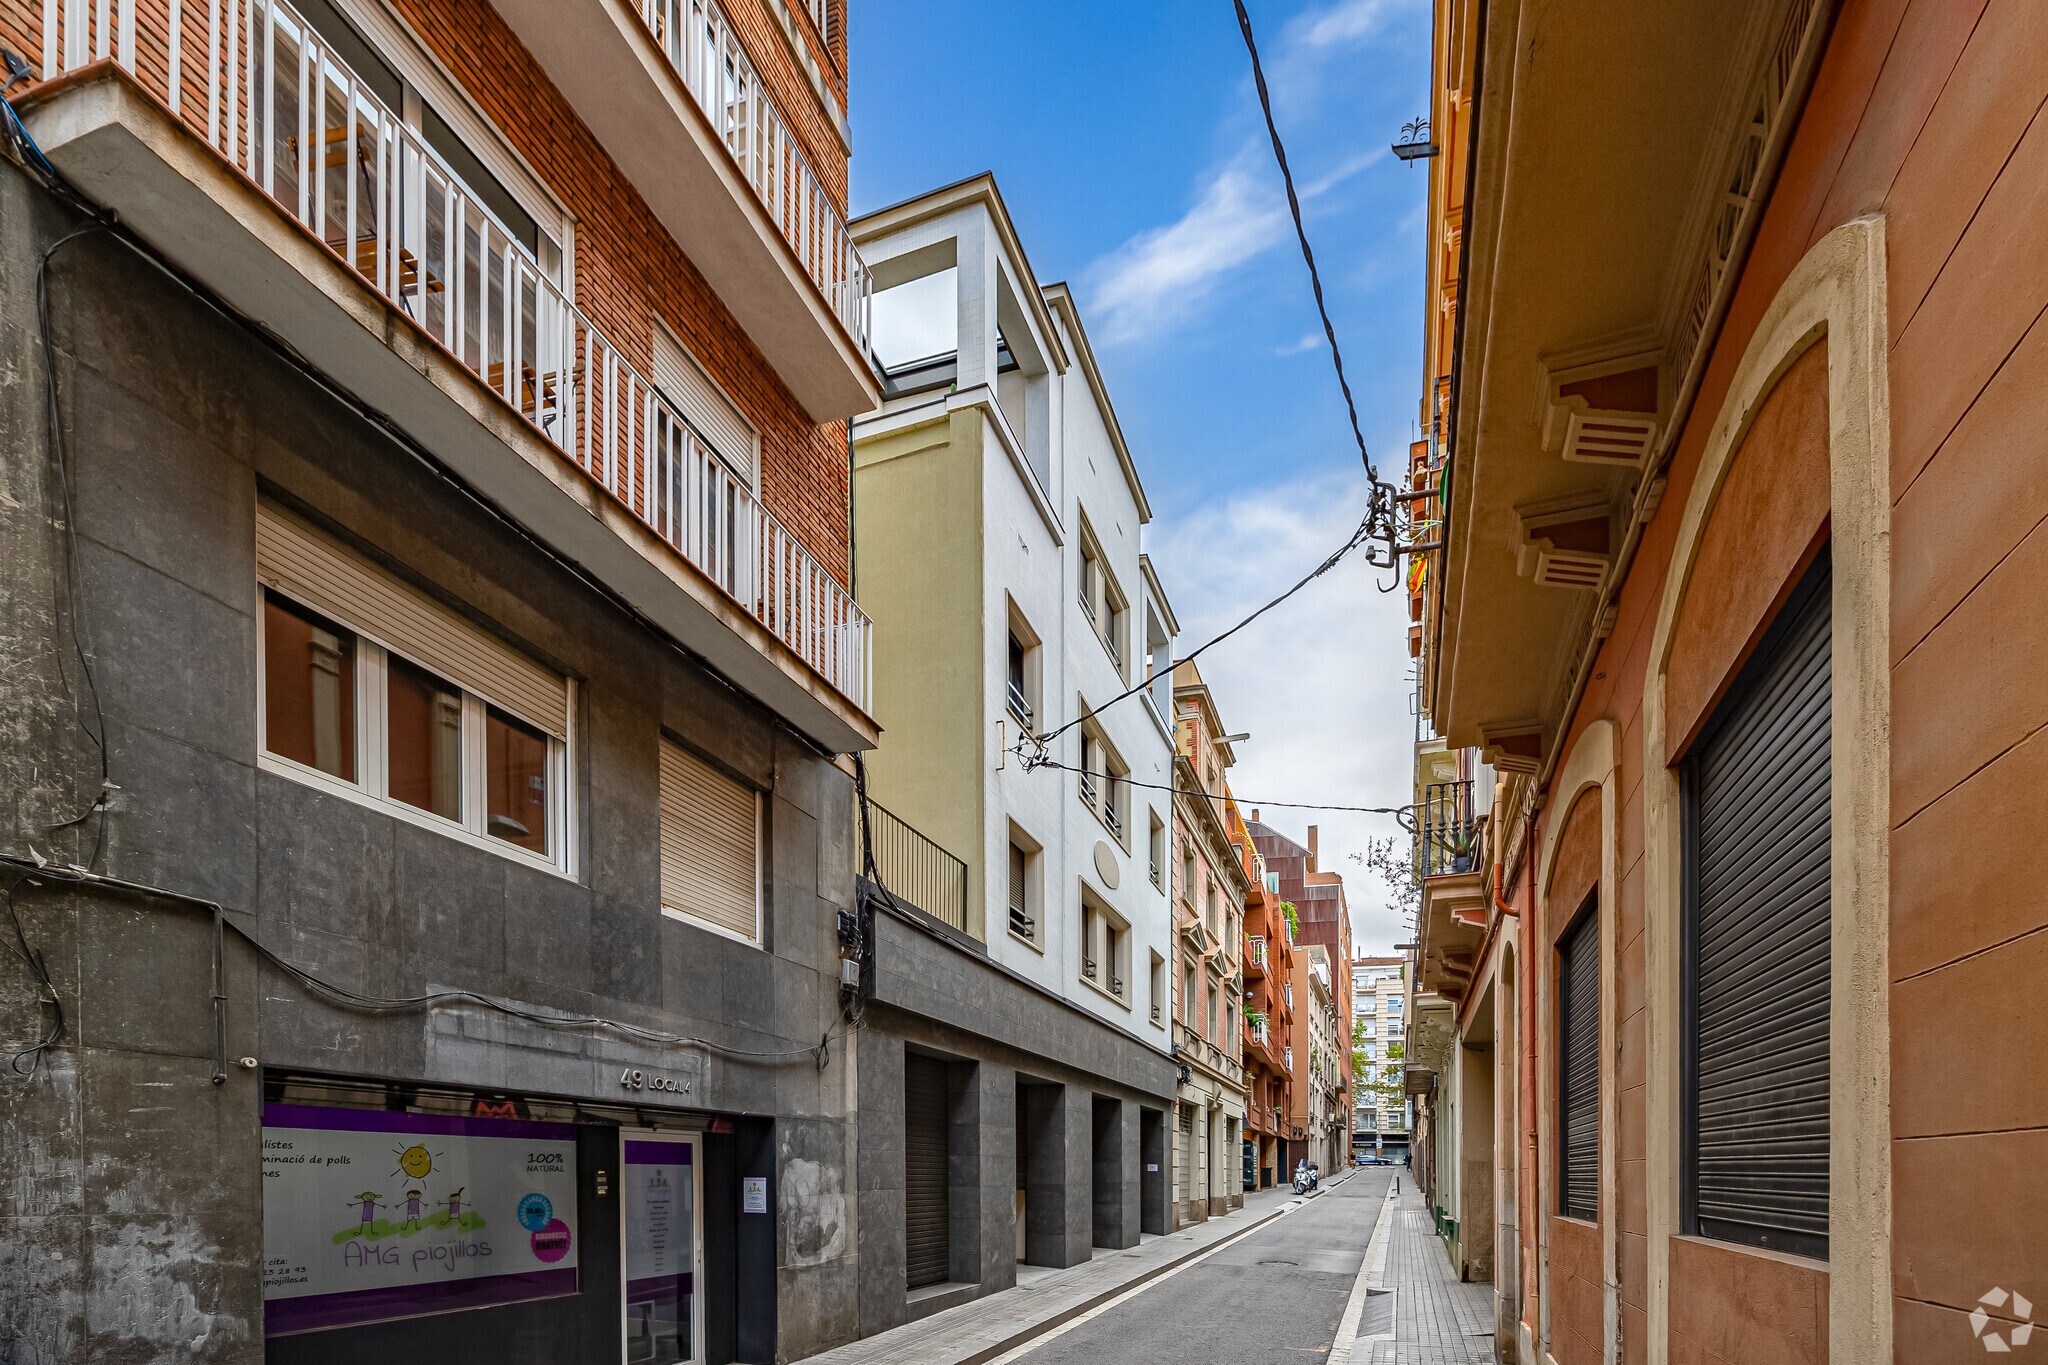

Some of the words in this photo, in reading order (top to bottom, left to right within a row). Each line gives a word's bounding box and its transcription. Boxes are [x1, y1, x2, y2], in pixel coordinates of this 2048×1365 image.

[620, 1068, 643, 1089] 49
[685, 1081, 691, 1093] 4
[309, 1155, 323, 1164] de
[326, 1155, 351, 1167] polls
[528, 1153, 564, 1164] 100%
[344, 1241, 400, 1267] AMG
[412, 1240, 493, 1273] piojillos
